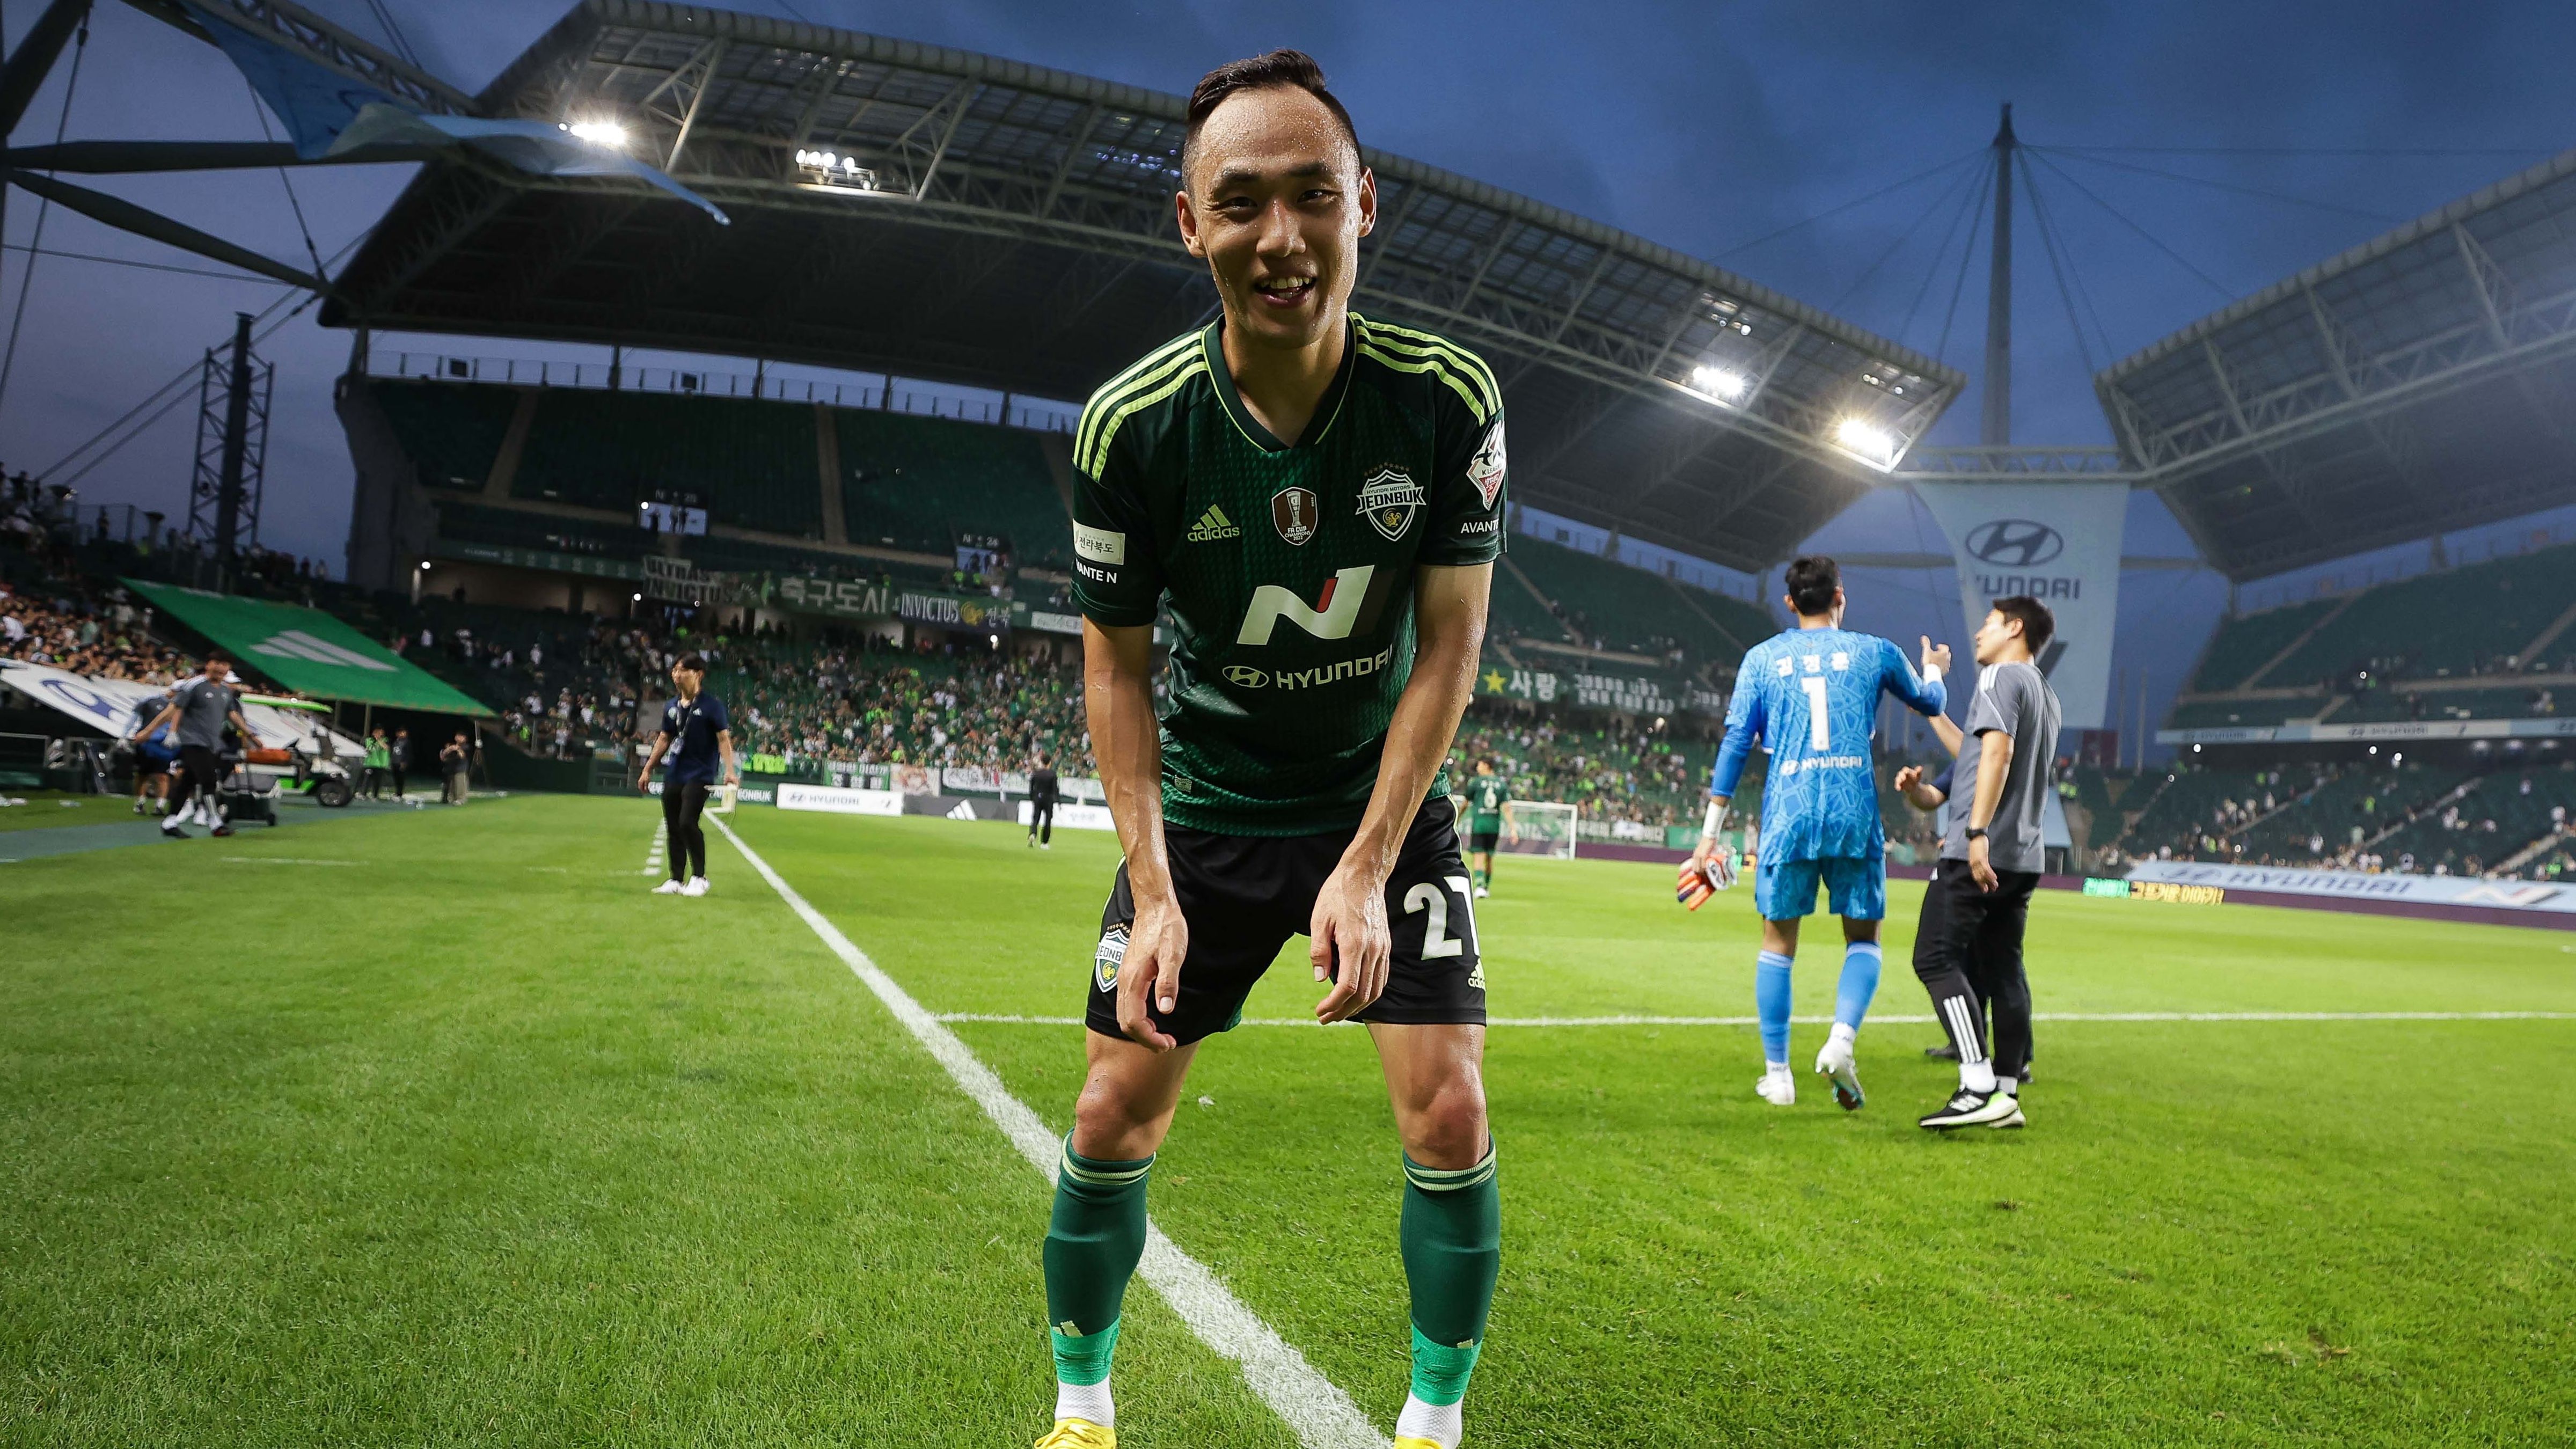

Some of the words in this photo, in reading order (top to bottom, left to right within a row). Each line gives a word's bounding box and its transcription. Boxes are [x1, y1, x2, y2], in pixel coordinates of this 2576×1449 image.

[1359, 489, 1425, 510] JEONBUK
[1389, 484, 1411, 492] MOTORS
[1079, 536, 1114, 553] 전라북도
[1187, 526, 1240, 542] adidas
[1075, 557, 1104, 581] VANTE
[1106, 571, 1117, 584] N
[781, 576, 888, 614] 축구도시
[1975, 574, 2081, 599] UNDAI
[901, 592, 961, 624] INVICTUS
[1509, 669, 1557, 701] 사랑
[1801, 676, 1830, 751] 1
[1802, 756, 1862, 771] HYUNDAI
